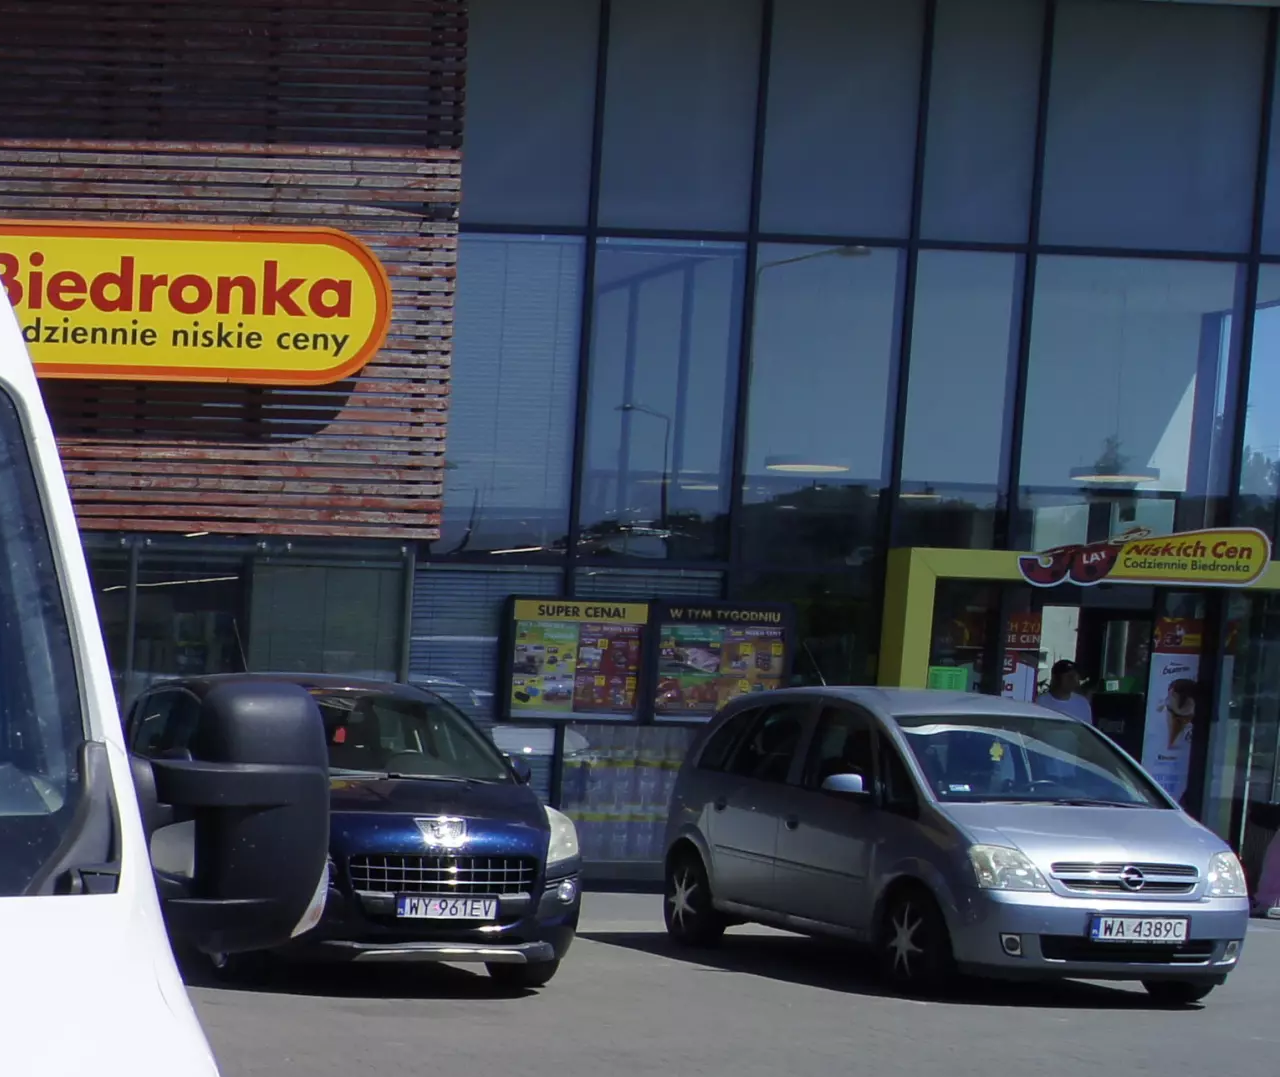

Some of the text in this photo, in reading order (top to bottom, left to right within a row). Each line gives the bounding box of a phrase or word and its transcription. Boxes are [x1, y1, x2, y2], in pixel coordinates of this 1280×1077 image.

[172, 320, 264, 349] niskie
[276, 332, 350, 357] ceny
[1125, 541, 1253, 560] Niskich Cen
[1123, 557, 1250, 573] Codziennie Biedronka
[538, 604, 626, 619] SUPER CENA!
[669, 608, 782, 623] W TYM TYGODNIU
[409, 899, 492, 917] WY 961EV
[1104, 920, 1183, 938] WA 4389C
